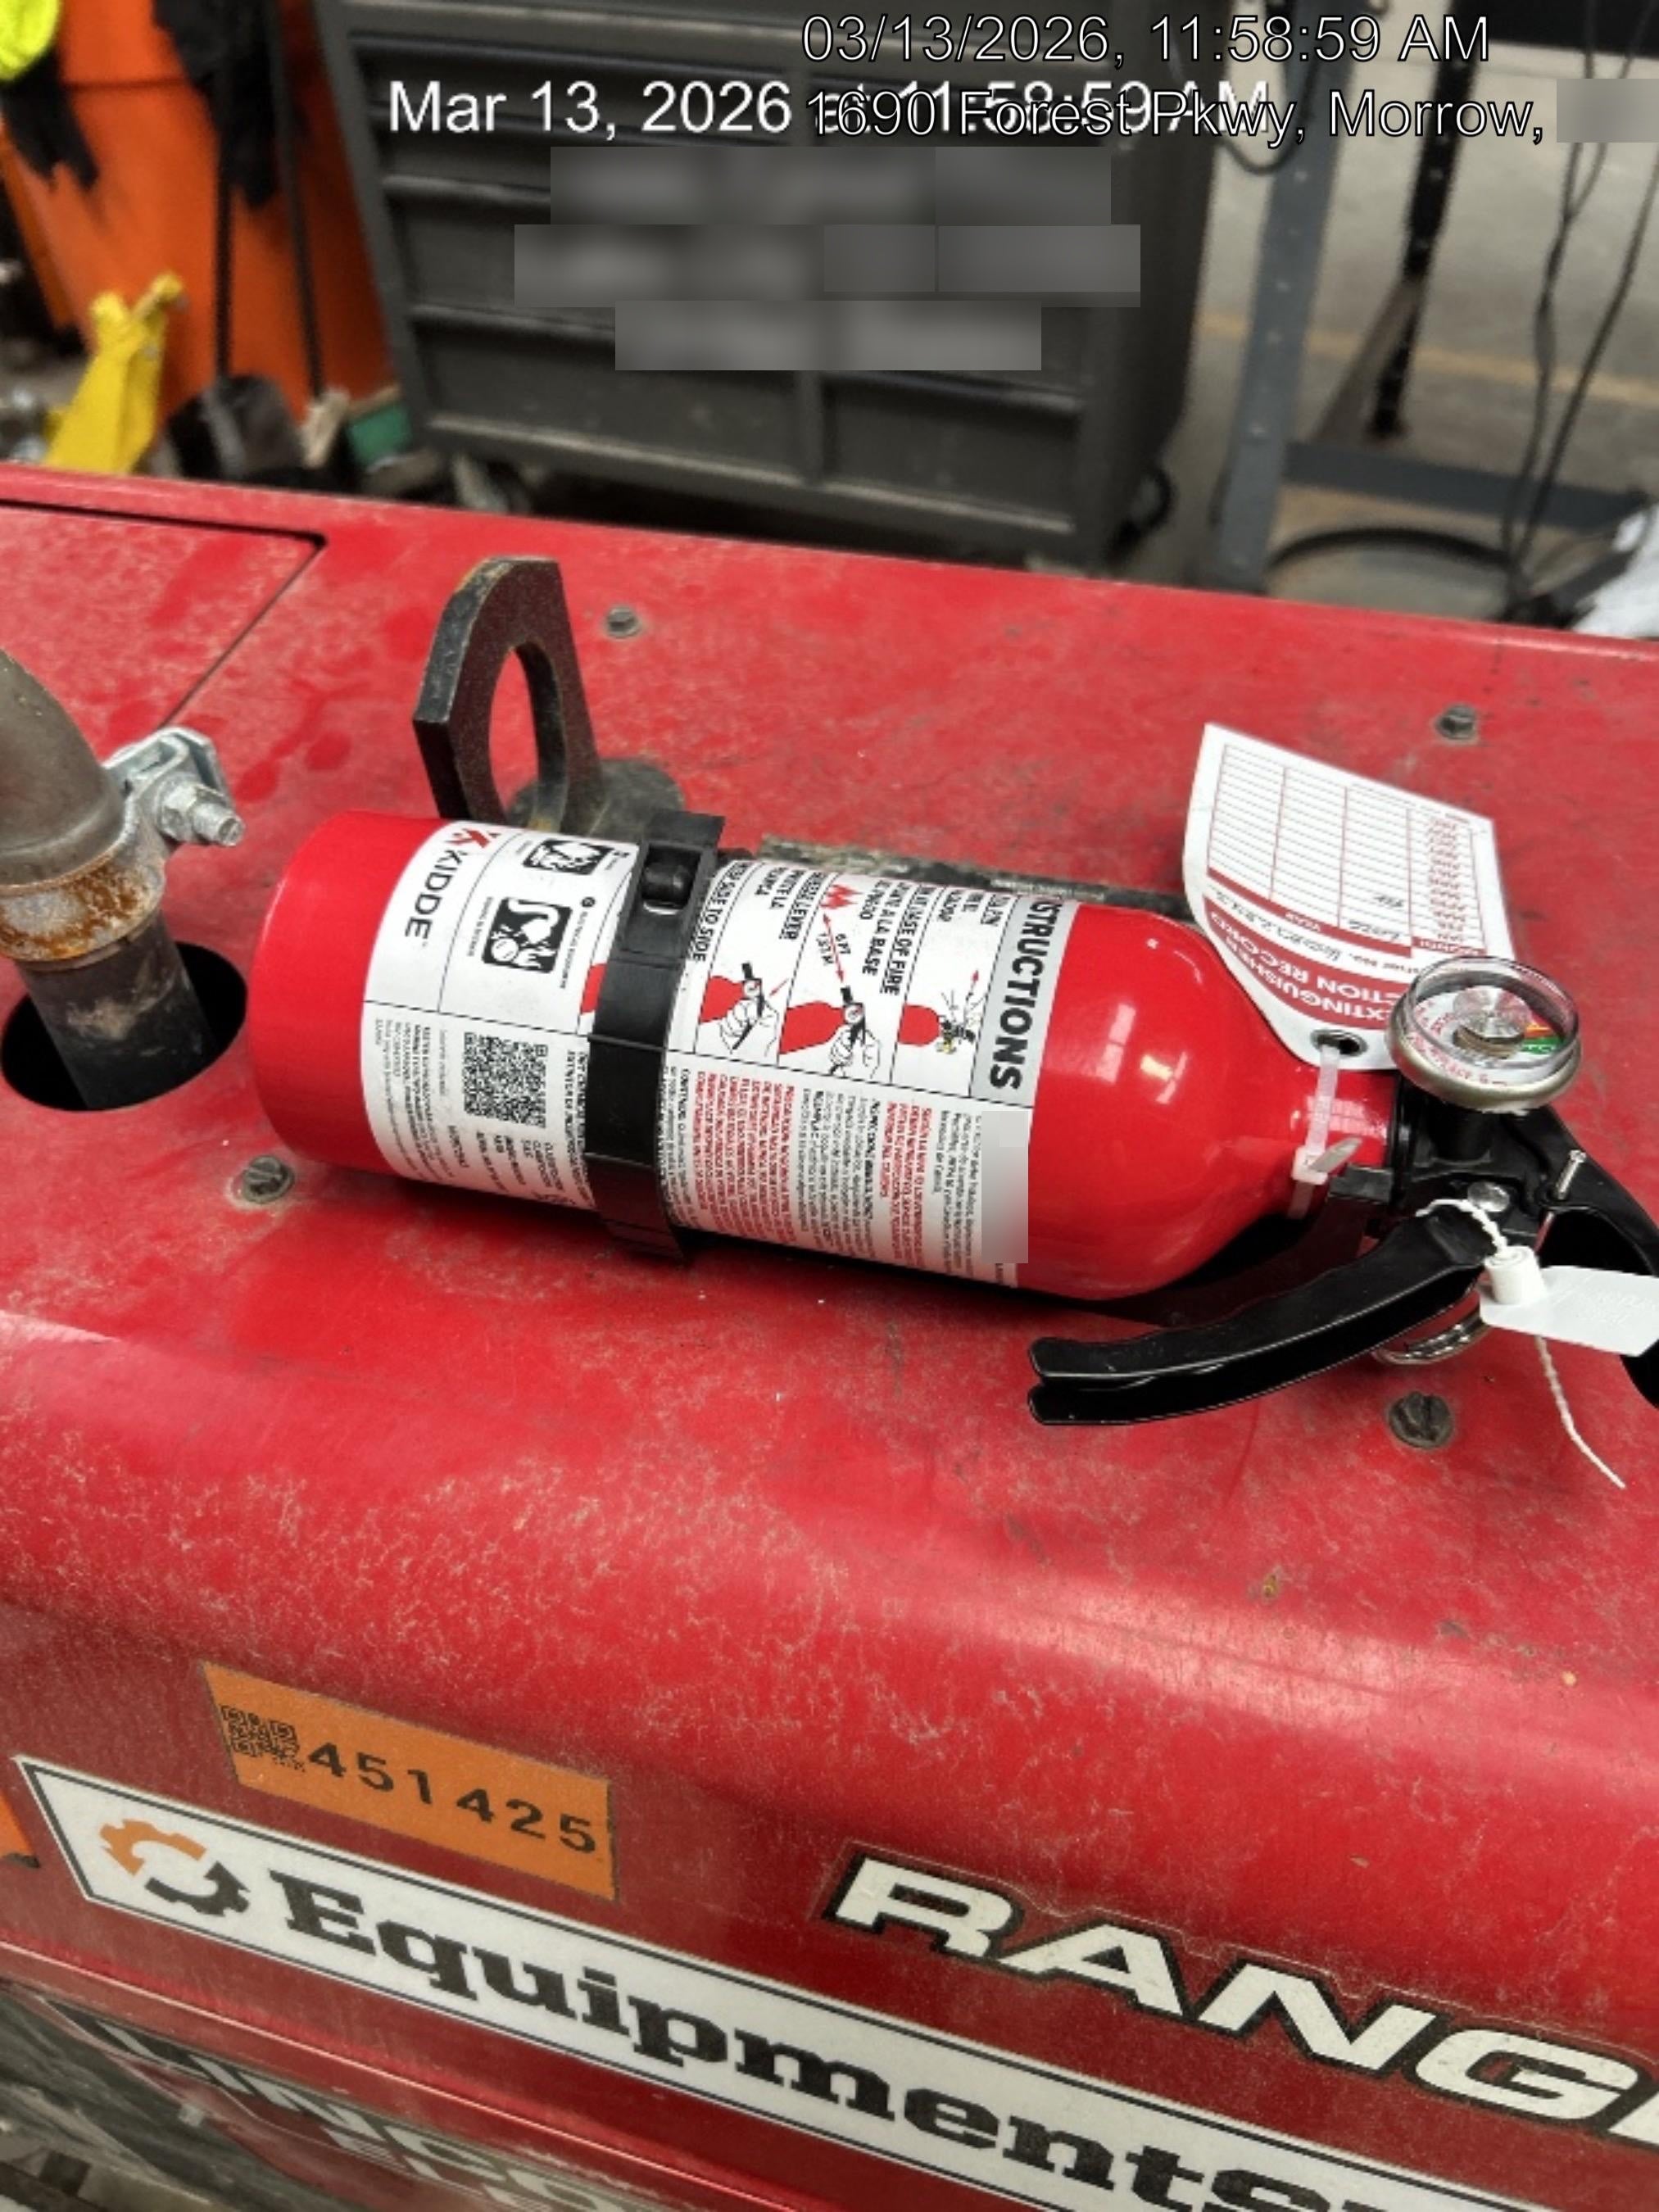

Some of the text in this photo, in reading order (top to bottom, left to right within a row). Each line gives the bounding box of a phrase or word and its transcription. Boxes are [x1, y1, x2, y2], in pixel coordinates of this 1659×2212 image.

[404, 849, 465, 938] KIDDE
[862, 937, 886, 976] BASE
[883, 959, 907, 995] FIRE
[1226, 935, 1390, 1022] XTINGUISHER
[307, 1742, 597, 1854] 451425
[270, 1868, 1388, 2212] EquipmentS
[831, 1853, 1659, 2148] RANG
